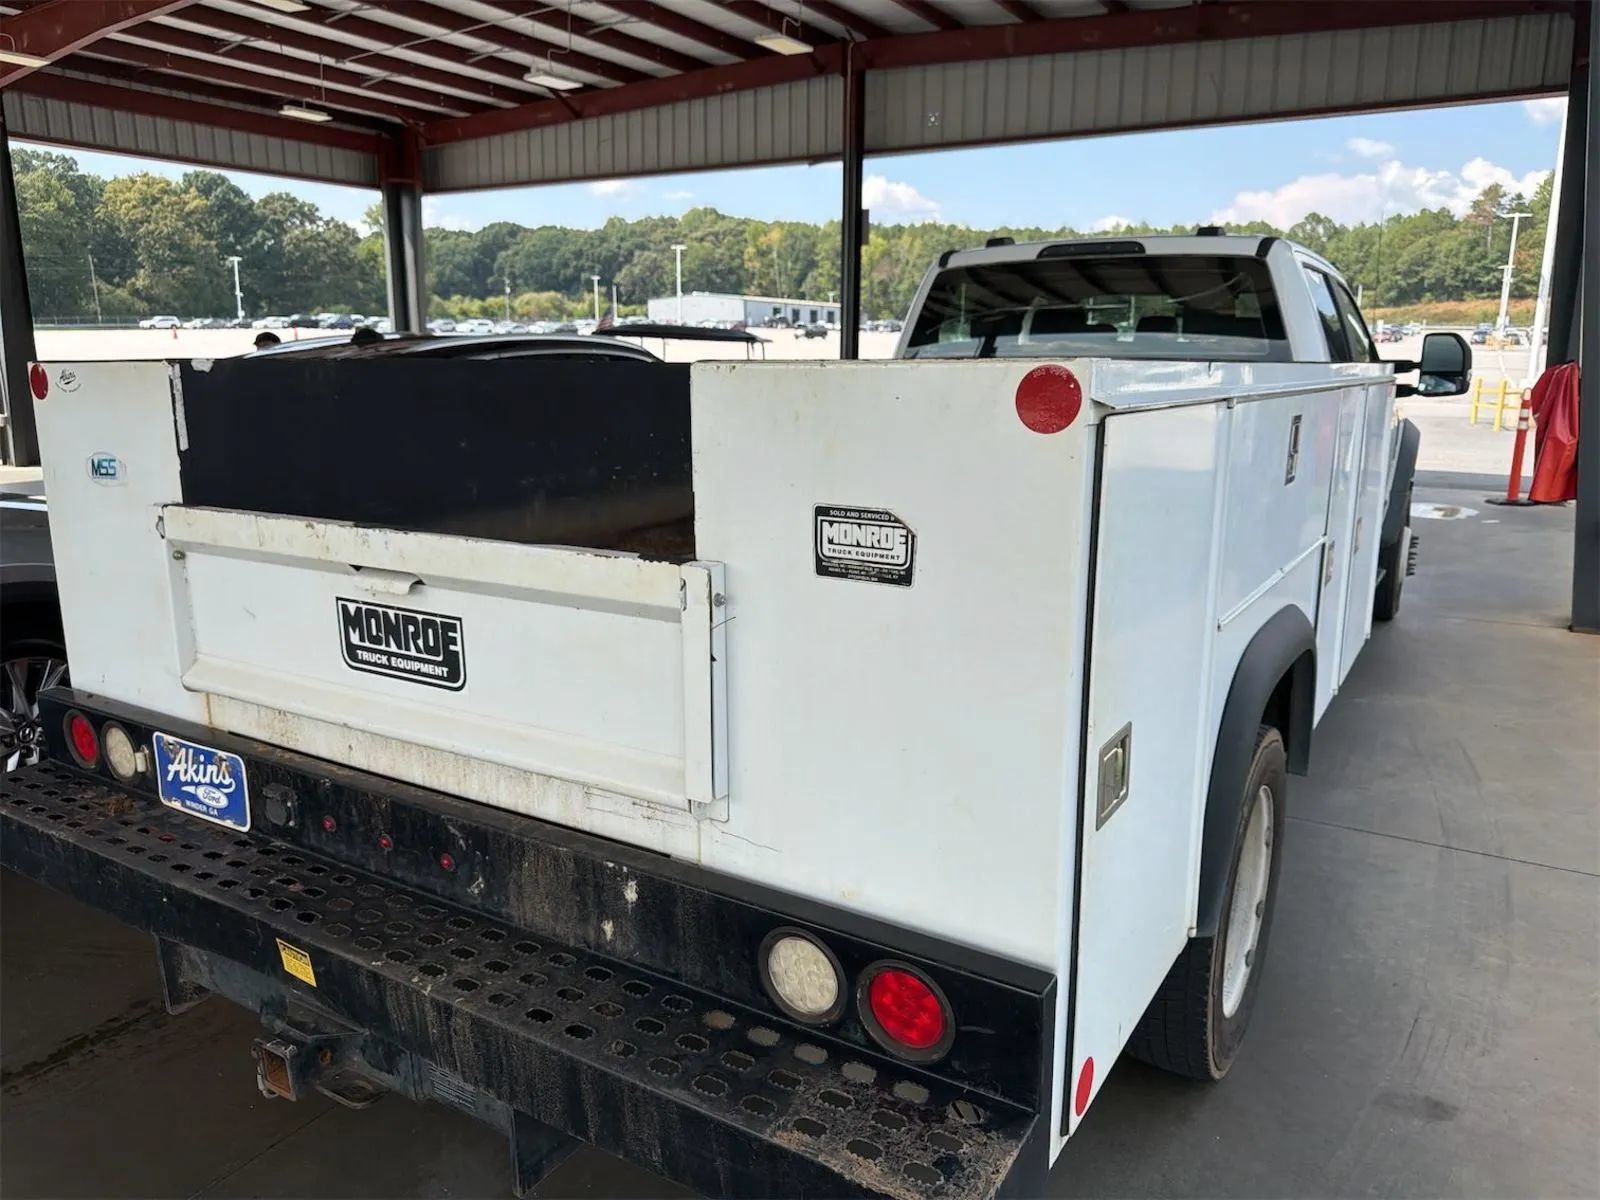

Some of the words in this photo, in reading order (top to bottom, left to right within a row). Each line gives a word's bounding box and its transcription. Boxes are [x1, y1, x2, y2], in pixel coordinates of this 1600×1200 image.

[91, 458, 117, 476] MSS
[829, 509, 846, 517] SOLD
[860, 512, 890, 521] SERVICED
[821, 521, 908, 550] MONROE
[827, 547, 853, 556] TRUCK
[855, 549, 901, 561] EQUIPMENT
[340, 602, 459, 659] MONROE
[355, 650, 390, 666] TRUCK
[390, 657, 449, 678] EQUIPMENT
[167, 747, 236, 790] Akins
[202, 788, 221, 804] Ford
[208, 807, 219, 817] GA
